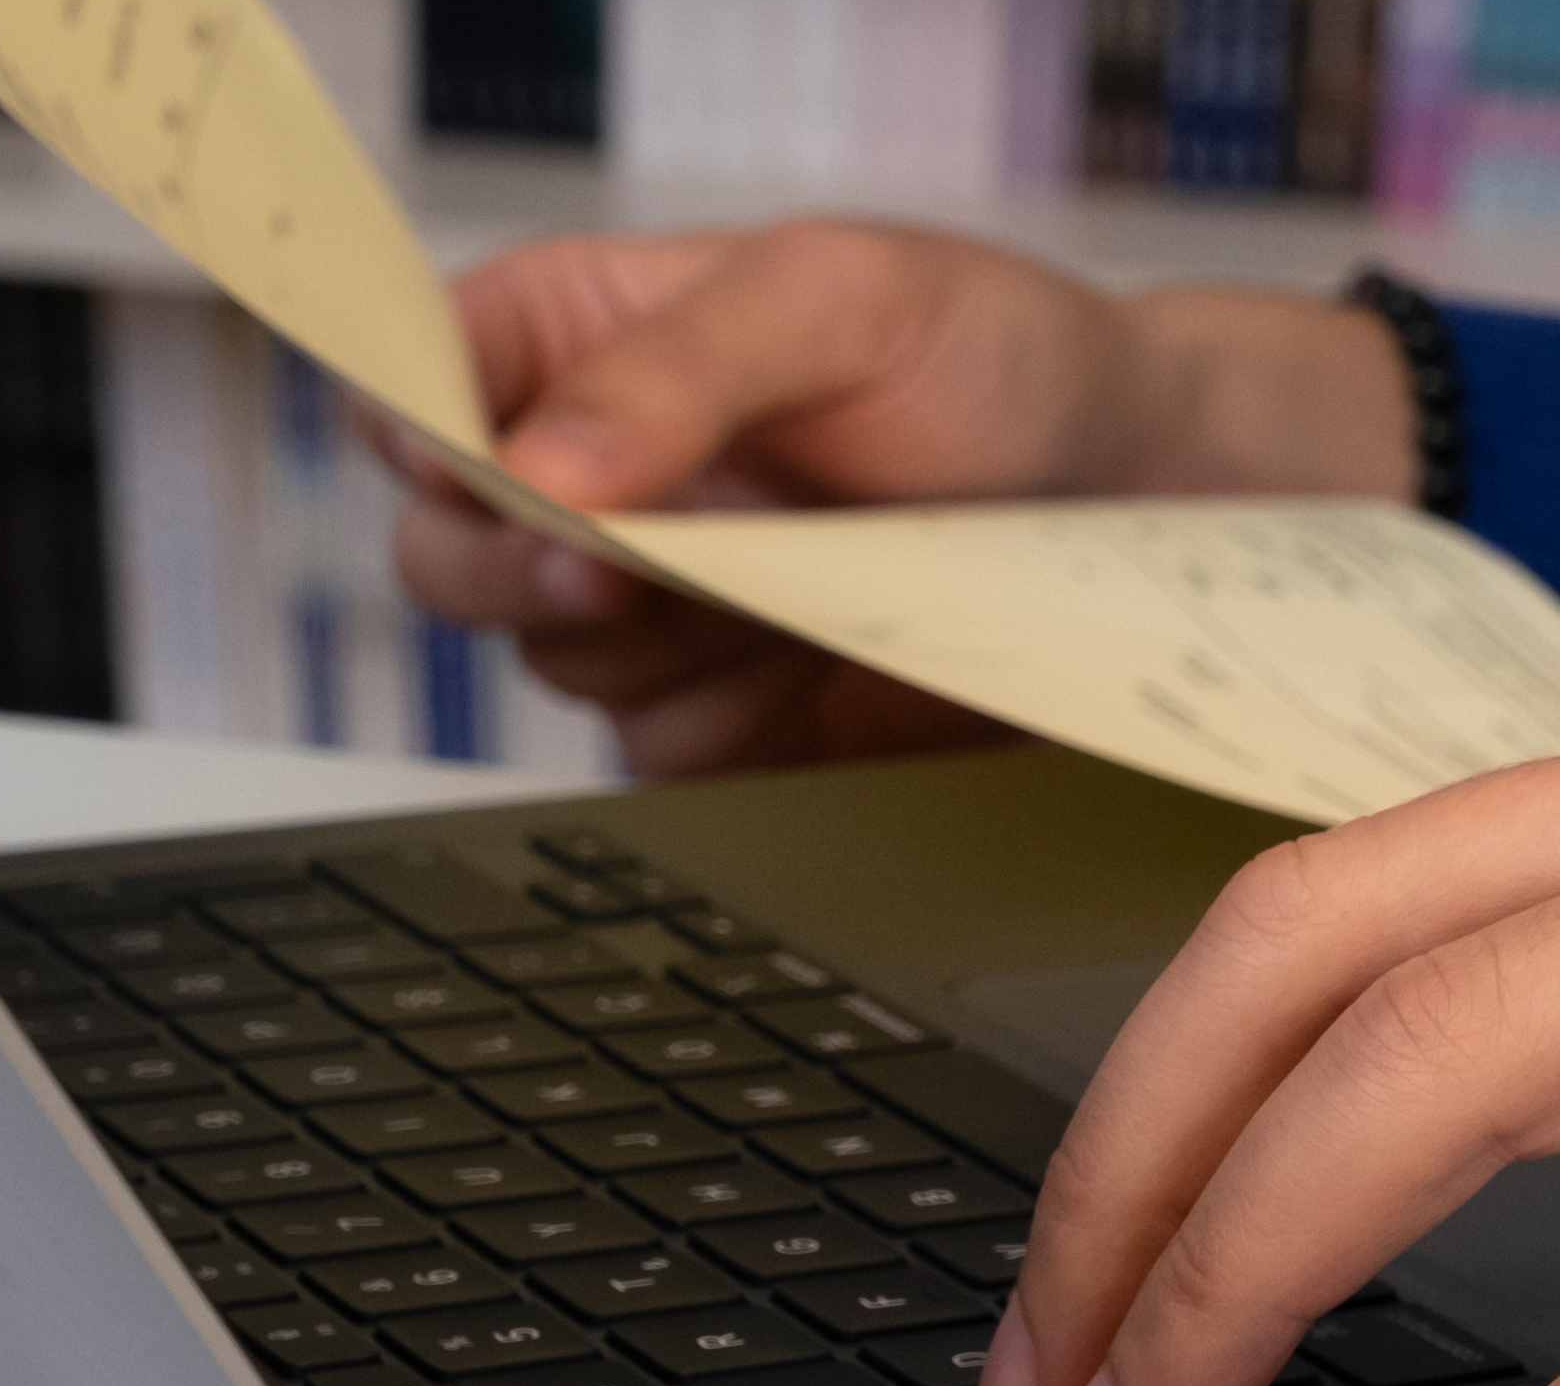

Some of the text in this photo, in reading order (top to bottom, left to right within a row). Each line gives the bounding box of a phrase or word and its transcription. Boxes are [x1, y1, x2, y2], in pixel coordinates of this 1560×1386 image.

[688, 1183, 740, 1203] H
[909, 1188, 958, 1207] B
[773, 1237, 820, 1255] G
[412, 1268, 459, 1287] 6
[608, 1276, 655, 1293] T
[857, 1293, 907, 1311] F
[492, 1327, 540, 1345] 5
[696, 1331, 745, 1351] R
